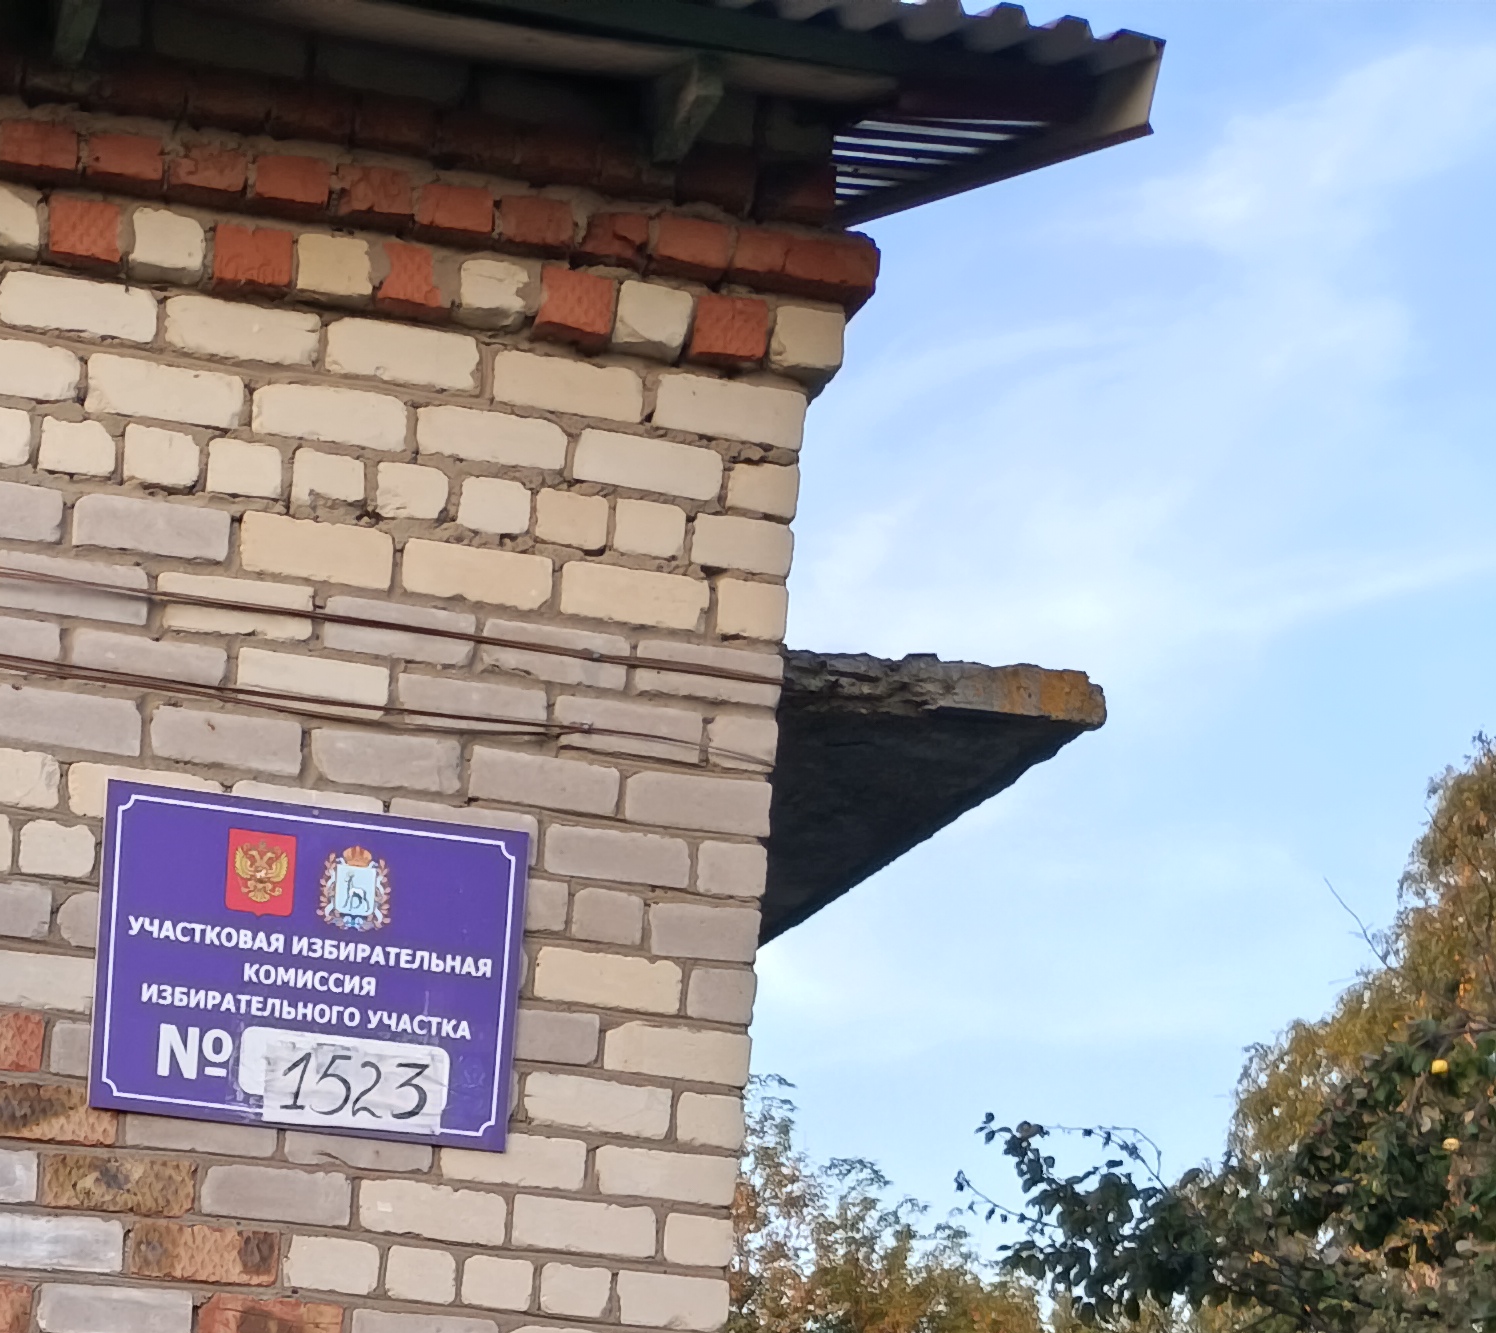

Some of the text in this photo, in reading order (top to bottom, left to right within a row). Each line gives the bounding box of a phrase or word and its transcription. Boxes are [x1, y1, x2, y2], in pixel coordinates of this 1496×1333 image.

[127, 915, 493, 978] УЧАСТКОВАЯ ИЗБИРАТЕЛЬНАЯ
[243, 962, 377, 997] КОМИССИЯ
[141, 983, 472, 1040] ИЗБИРАТЕЛЬНОГО УЧАСТКА
[280, 1051, 431, 1120] 1523
